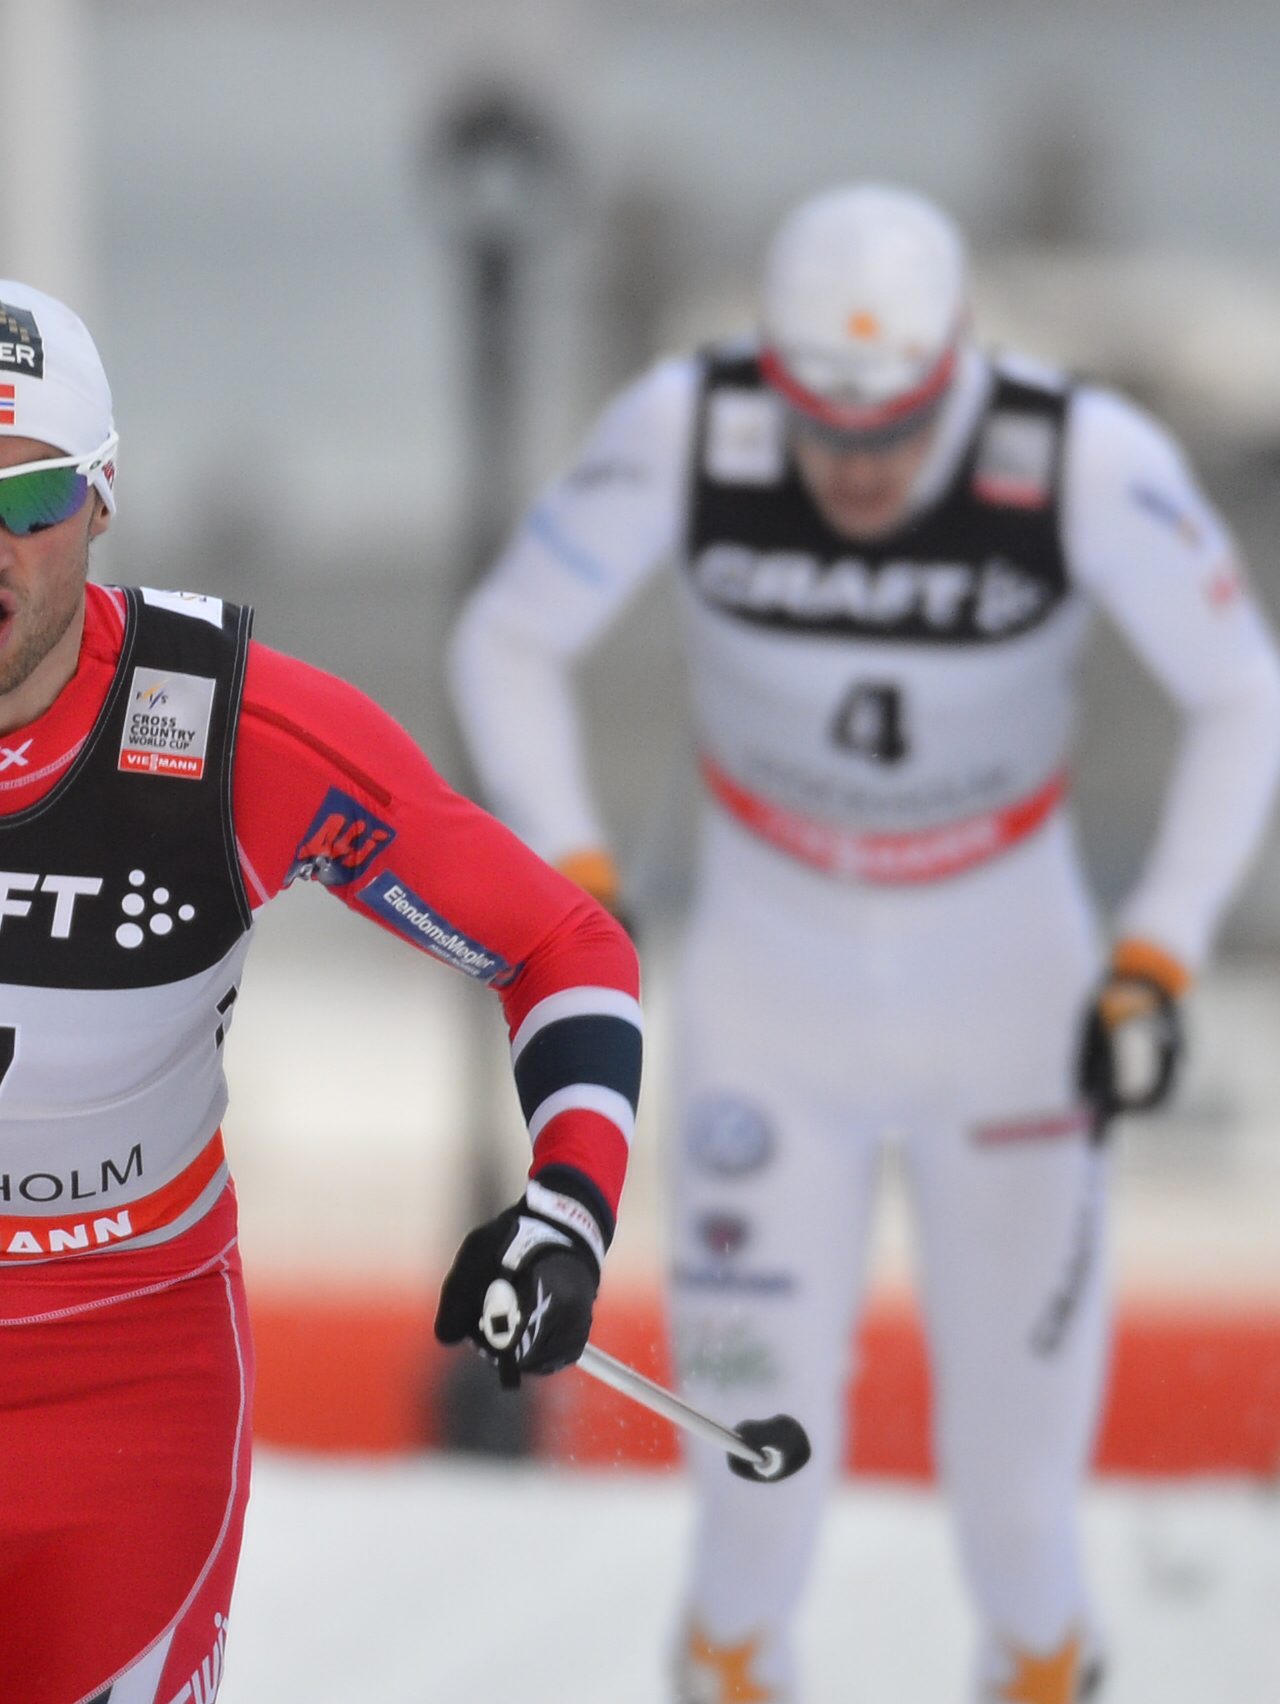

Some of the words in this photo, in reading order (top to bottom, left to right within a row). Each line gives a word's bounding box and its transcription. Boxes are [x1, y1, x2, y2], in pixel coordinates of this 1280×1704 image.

[132, 713, 177, 728] CROSS
[828, 677, 910, 771] 4
[130, 725, 196, 742] COUNTRY
[128, 736, 166, 748] WORLD
[169, 740, 190, 750] CUP
[383, 884, 496, 970] EiendomsMegler
